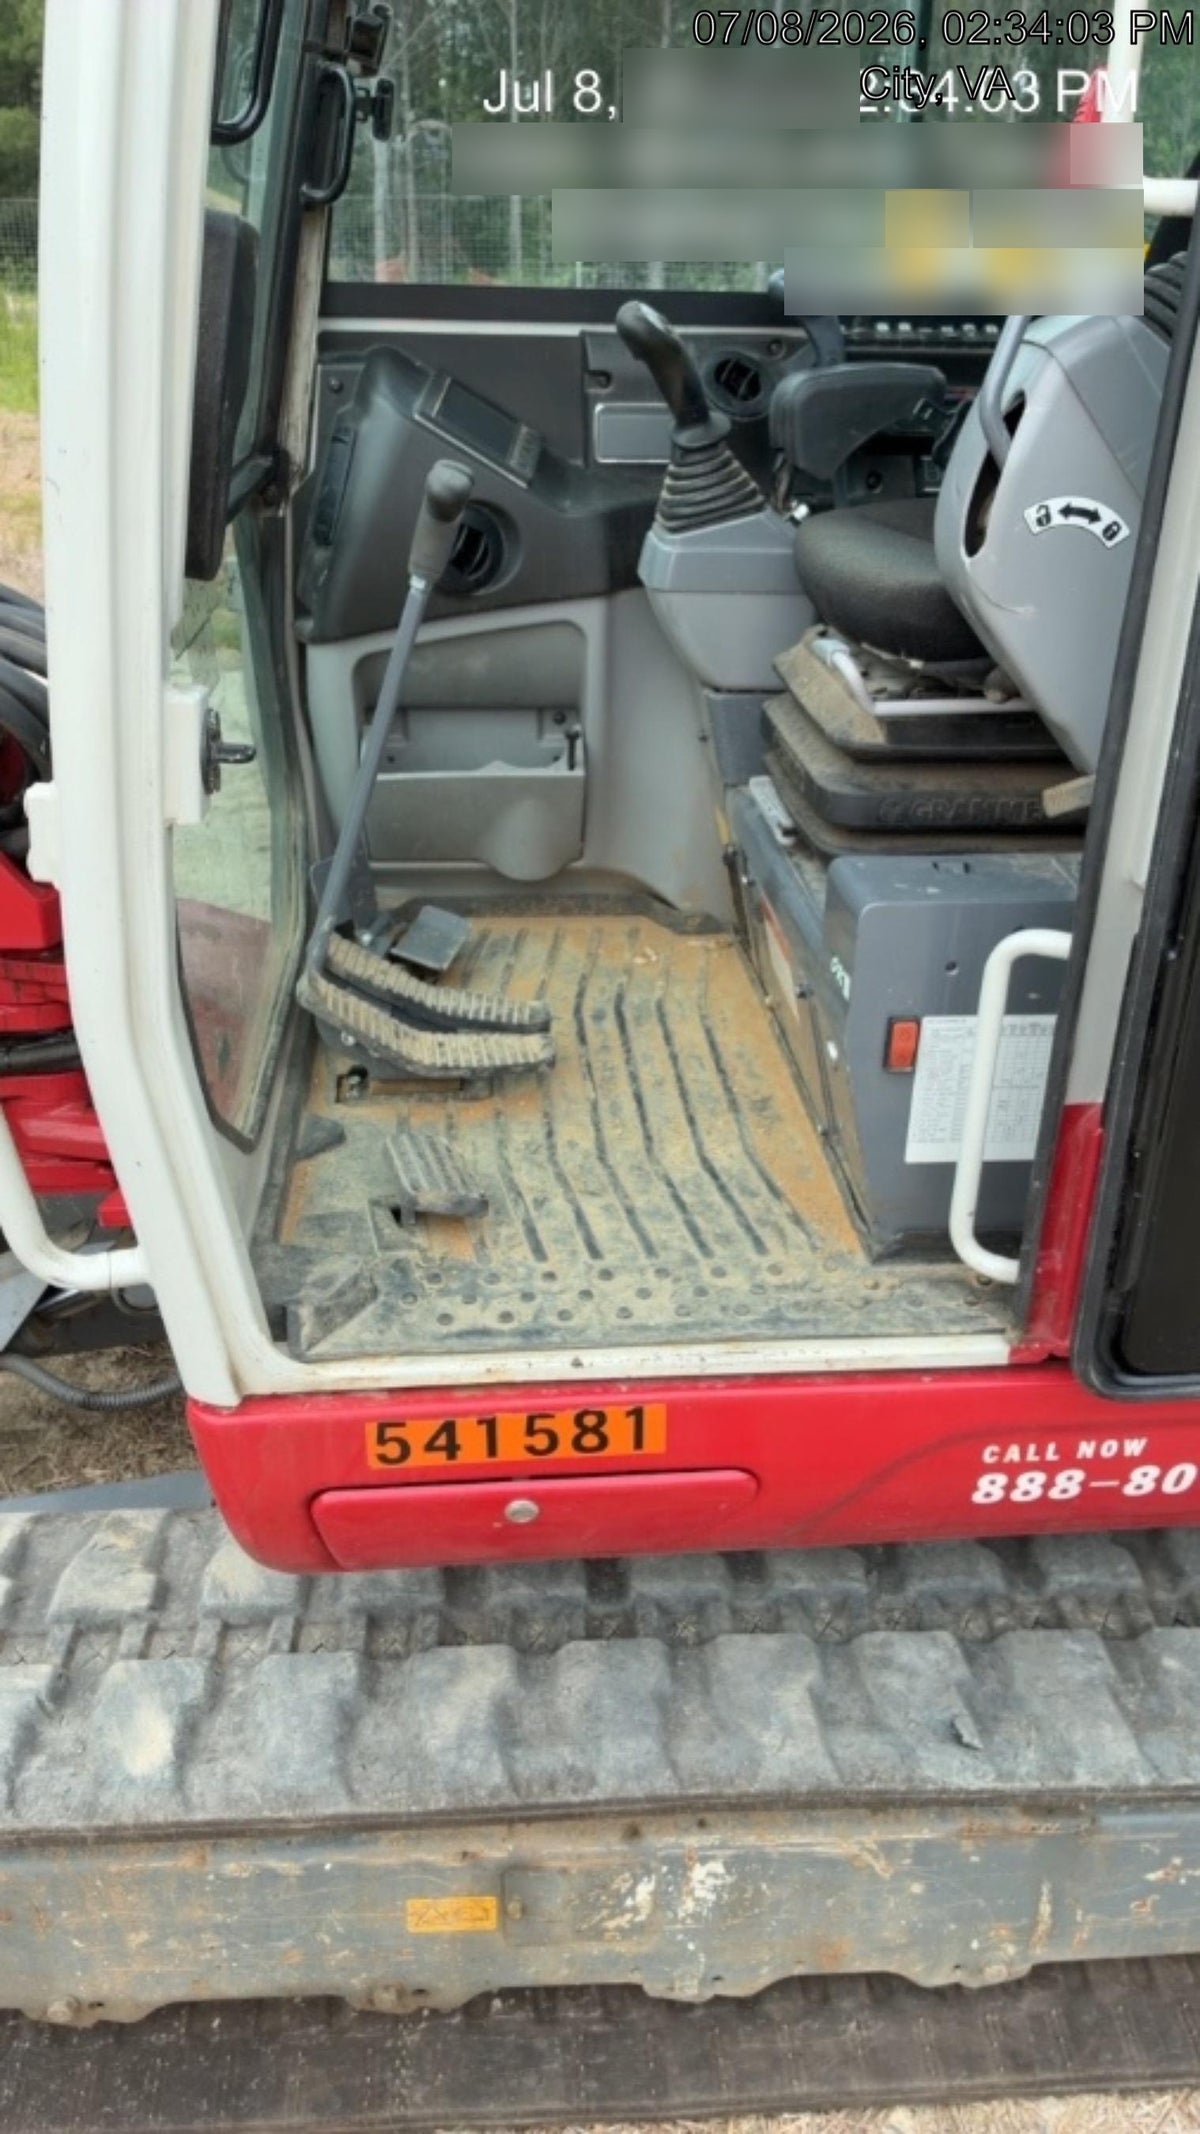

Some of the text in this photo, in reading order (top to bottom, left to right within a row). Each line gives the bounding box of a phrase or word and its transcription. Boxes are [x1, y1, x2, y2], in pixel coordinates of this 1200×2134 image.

[375, 1405, 645, 1465] 541581
[981, 1437, 1148, 1464] CALL NOW
[971, 1462, 1198, 1504] 888-80
